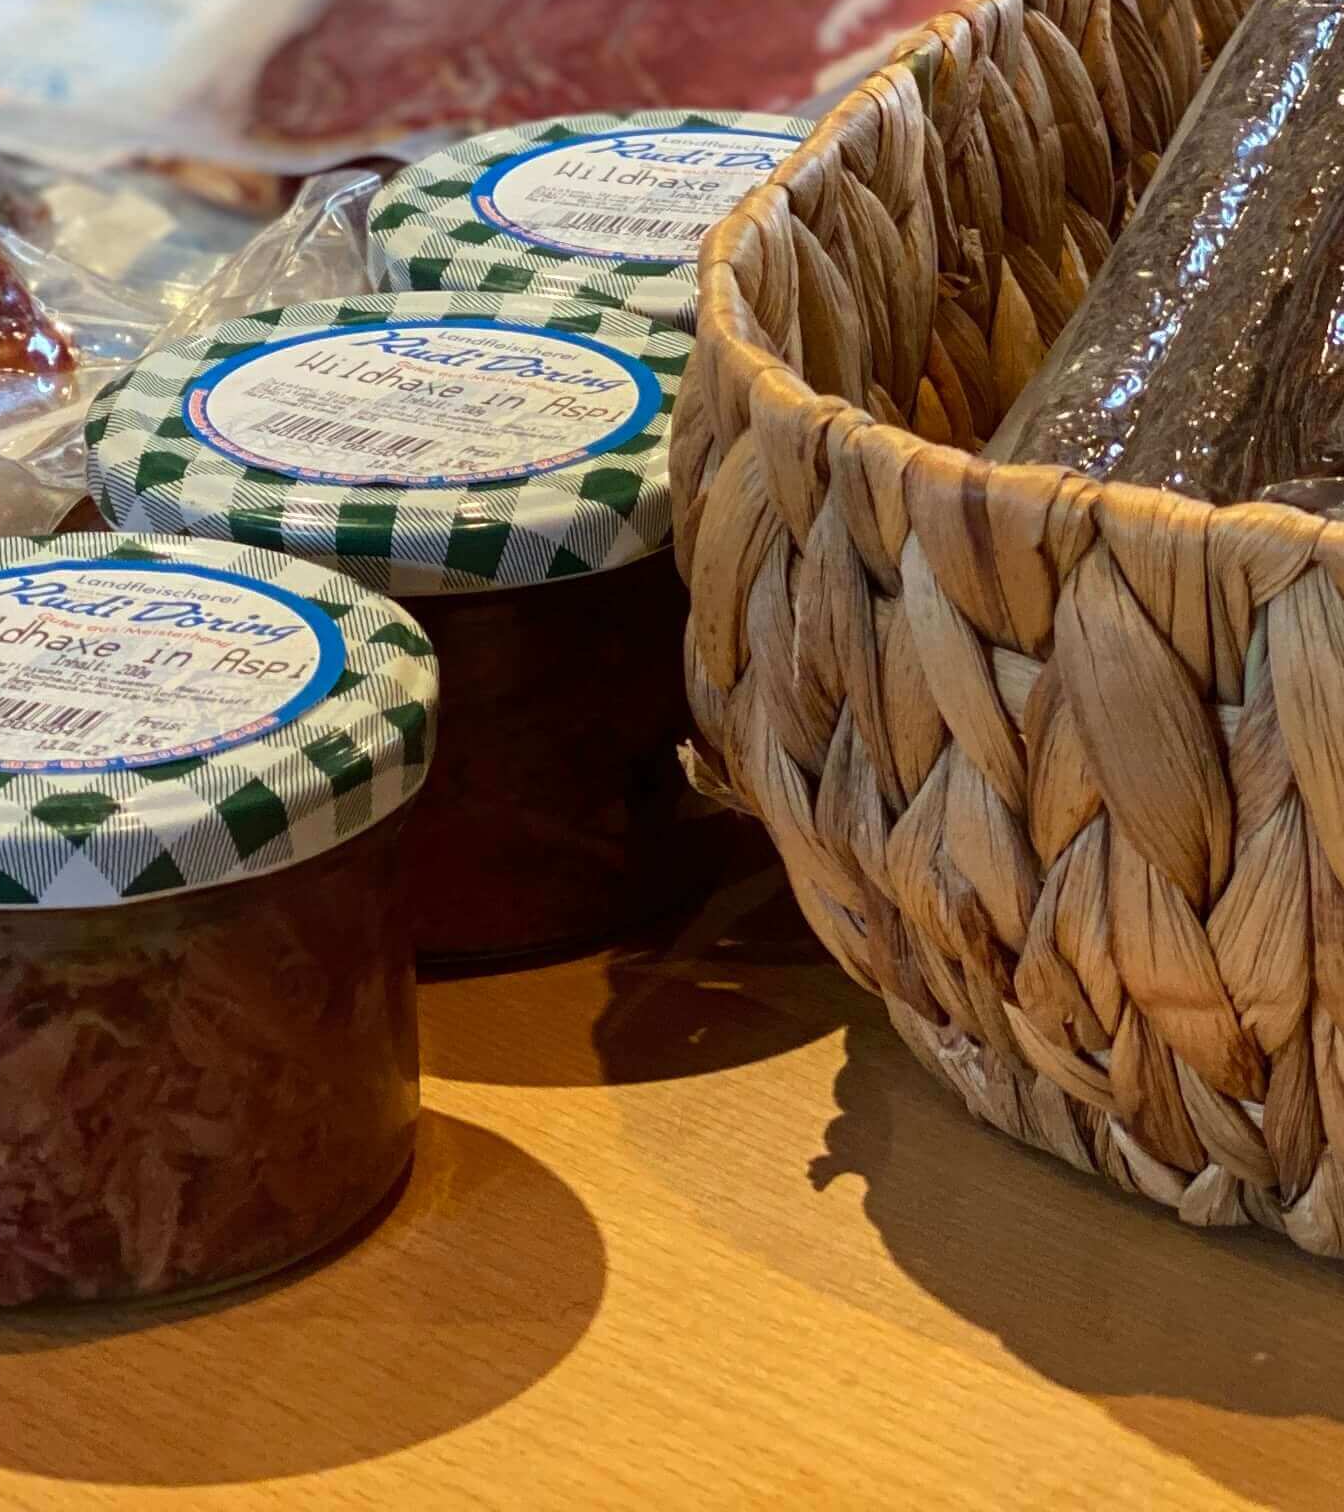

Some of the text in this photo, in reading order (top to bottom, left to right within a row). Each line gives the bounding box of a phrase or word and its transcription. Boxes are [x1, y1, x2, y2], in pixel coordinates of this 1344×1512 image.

[586, 138, 714, 165] Rudi
[553, 160, 721, 192] Wildhaxe
[437, 331, 579, 362] Landfleischerei
[295, 351, 464, 398] Wildhaxe
[350, 331, 632, 394] Rudi Döring
[76, 575, 243, 605] Landfleischerei
[129, 600, 305, 646] Döring
[142, 640, 193, 668] in
